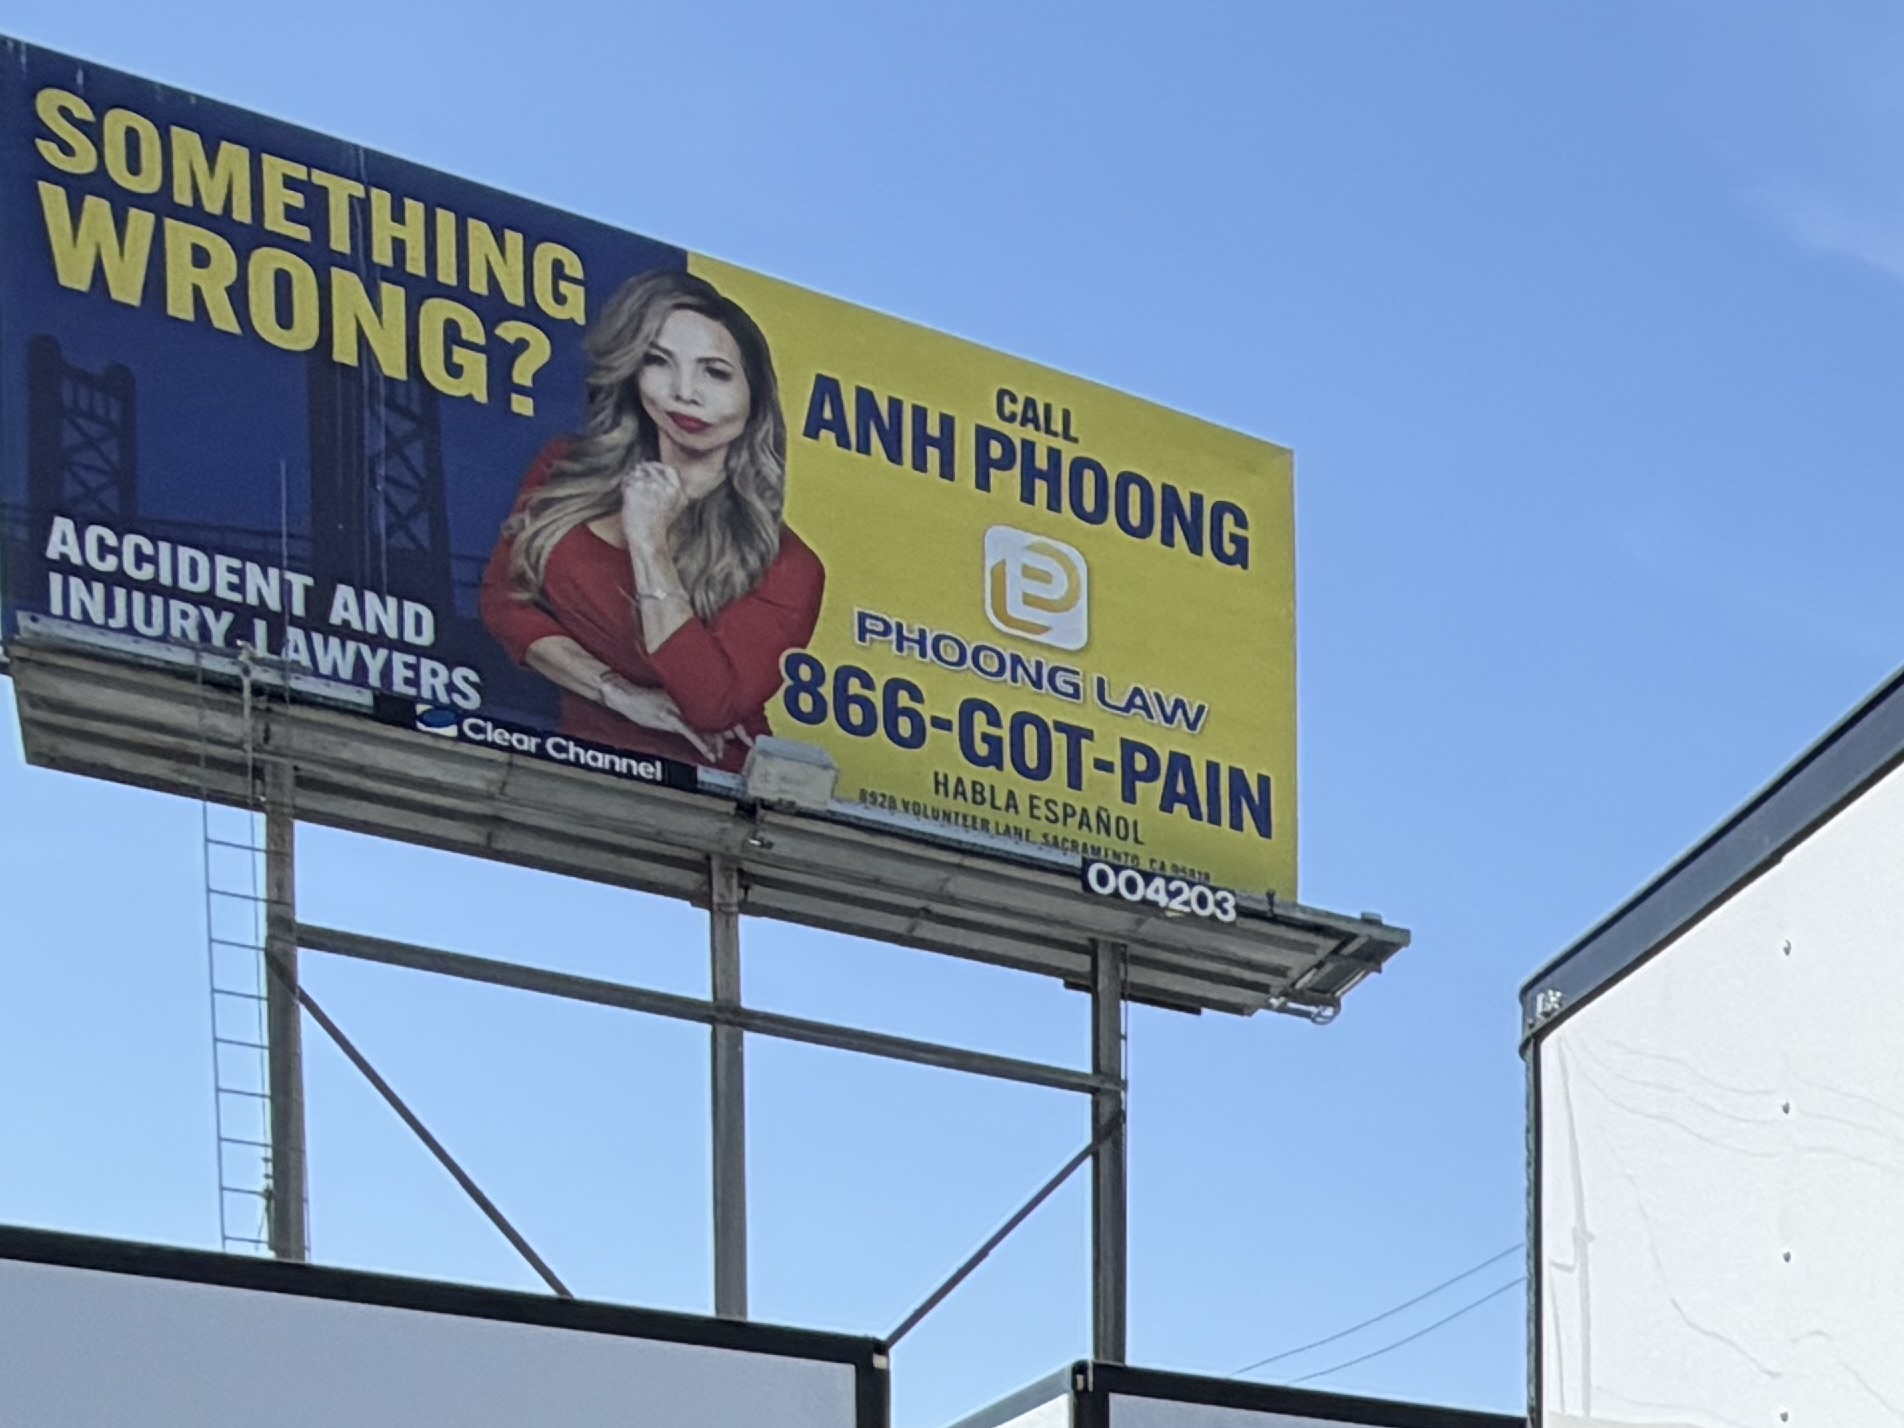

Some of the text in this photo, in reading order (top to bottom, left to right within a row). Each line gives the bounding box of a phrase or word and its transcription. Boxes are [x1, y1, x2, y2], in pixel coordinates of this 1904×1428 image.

[34, 87, 586, 325] SOMETHING
[37, 180, 553, 417] WRONG?
[802, 373, 1250, 570] ANH PHOONG
[995, 387, 1079, 444] CALL
[45, 516, 435, 647] ACCIDENT AND
[48, 572, 482, 710] INJURY LAWYERS
[855, 611, 1206, 731] PHOONG LAW
[462, 717, 662, 781] Clear Channel
[783, 653, 1272, 839] 866-GOT-PAIN
[934, 771, 1145, 845] HABLA ESPAÑOL
[1087, 862, 1237, 922] 004203
